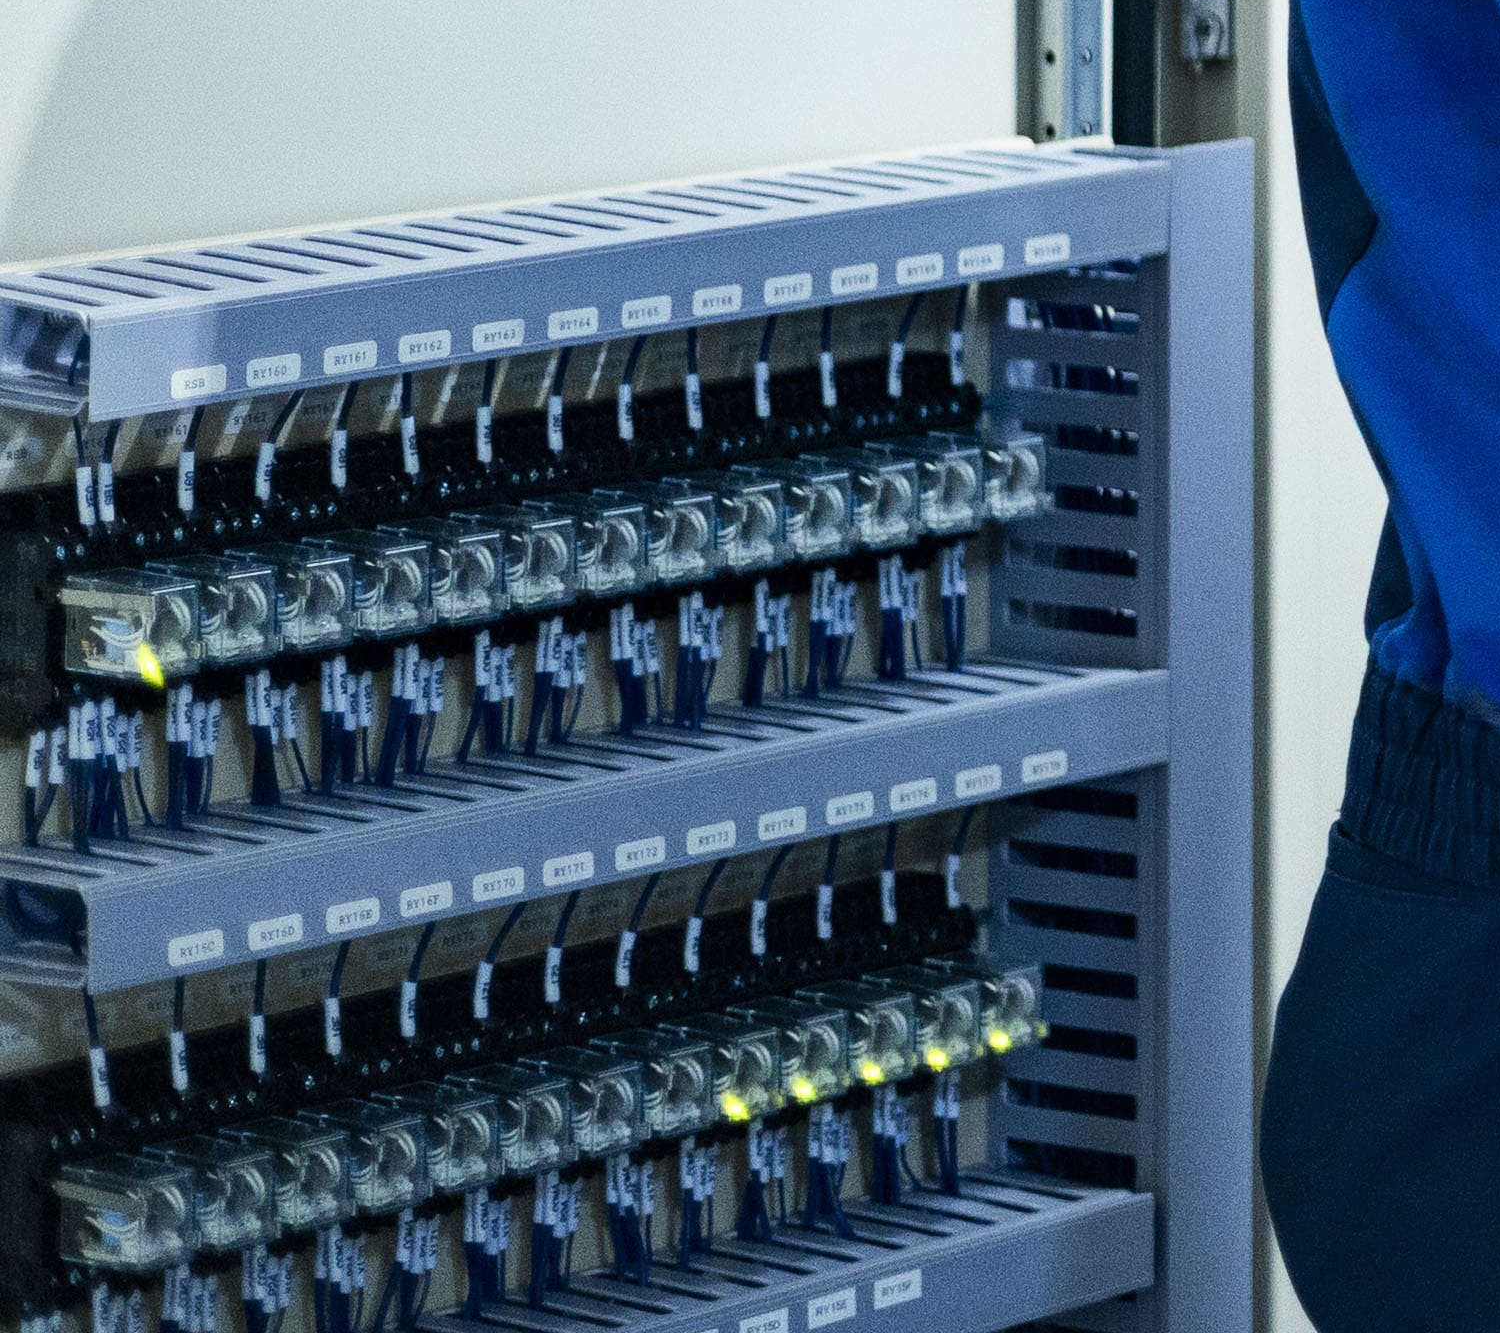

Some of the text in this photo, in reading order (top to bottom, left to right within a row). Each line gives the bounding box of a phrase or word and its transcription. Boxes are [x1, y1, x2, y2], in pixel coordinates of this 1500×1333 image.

[483, 328, 517, 343] RY163
[409, 340, 443, 355] RY162
[334, 350, 368, 366] RY161
[253, 363, 288, 380] RY160
[184, 377, 206, 390] RSB
[482, 877, 516, 893] RY170
[406, 893, 441, 911] RY16F
[338, 908, 374, 926] RY16E
[259, 925, 295, 942] RY16D
[179, 940, 216, 958] RY16C
